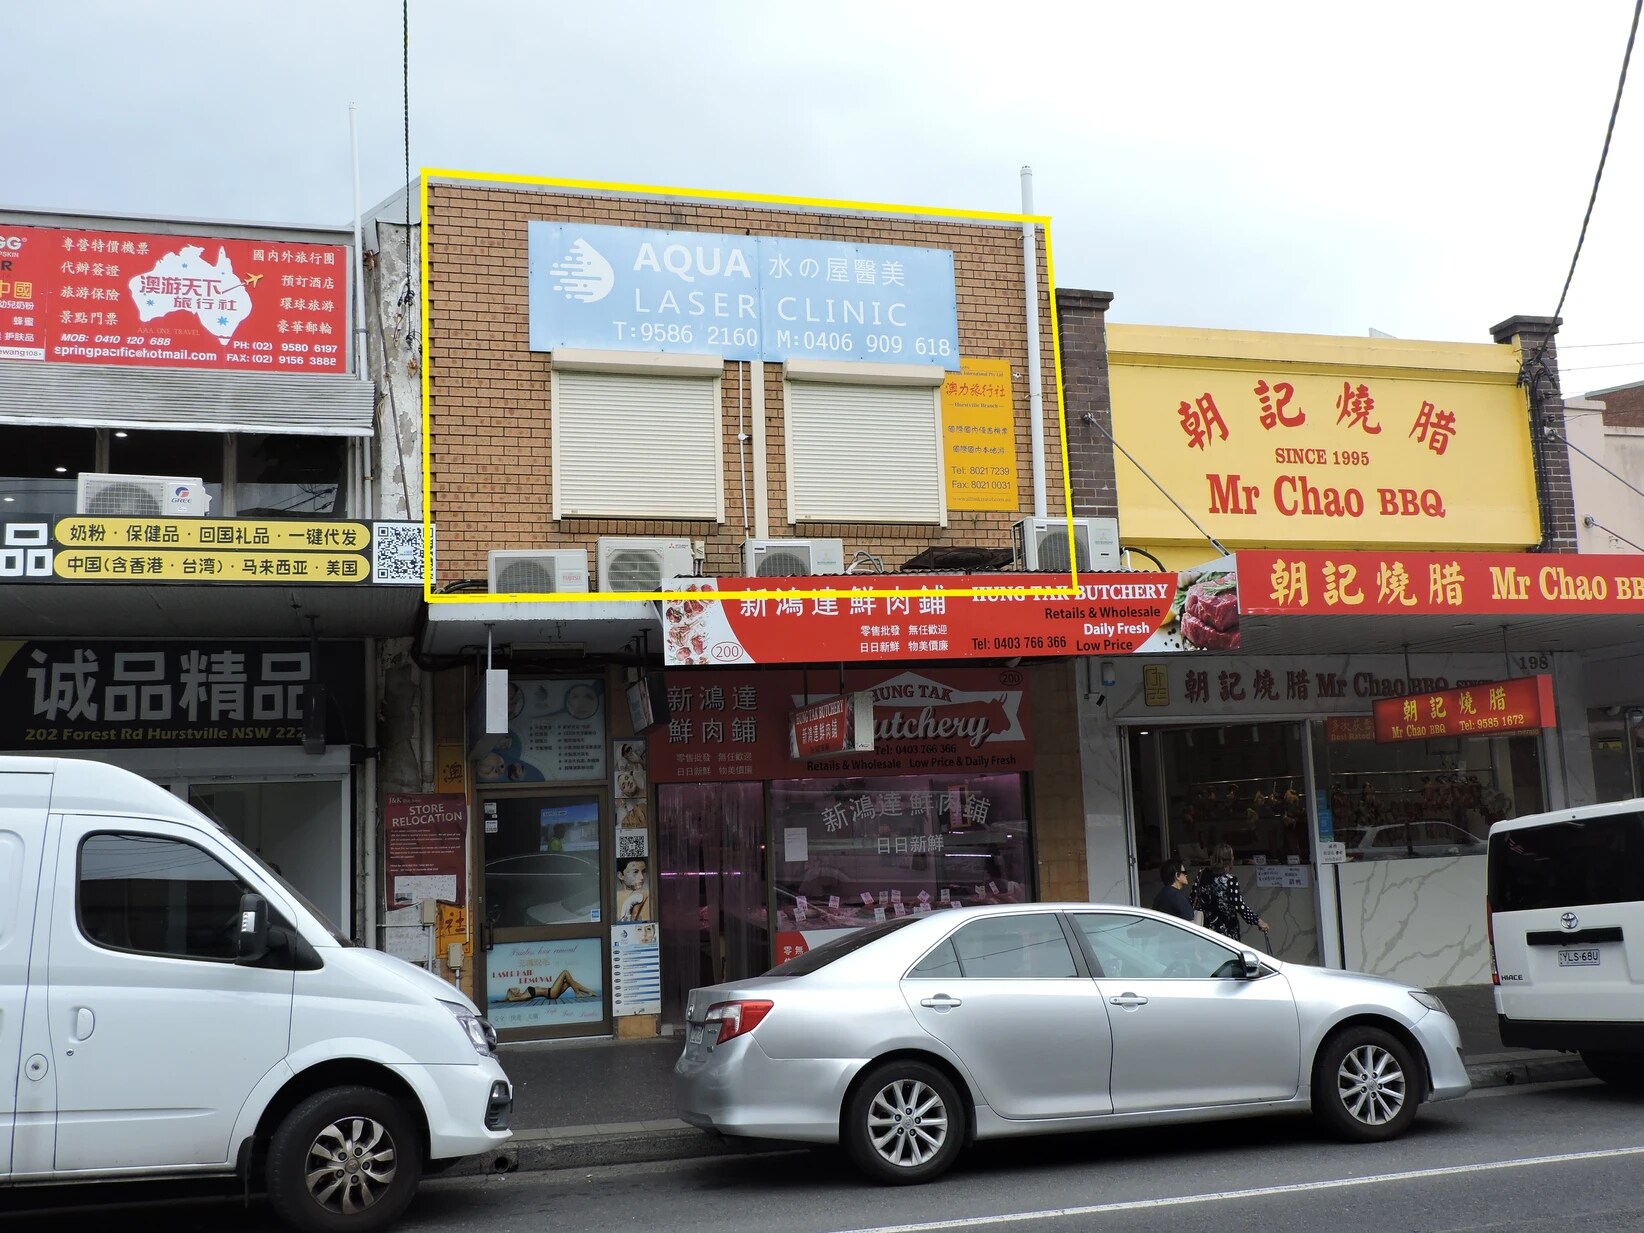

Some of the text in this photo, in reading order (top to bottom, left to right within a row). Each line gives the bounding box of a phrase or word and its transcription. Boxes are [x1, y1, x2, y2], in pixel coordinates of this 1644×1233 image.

[633, 243, 751, 283] AQUA
[769, 253, 905, 287] 水の屋醫美
[140, 275, 222, 297] 澳游天下
[281, 275, 334, 289] 預訂酒店
[173, 296, 238, 311] 旅行社
[635, 288, 907, 327] LASER CLINIC
[59, 310, 118, 326] 景點門票
[277, 319, 332, 334] 豪華郵輪
[61, 333, 171, 346] MOB: 0410 120 688
[174, 328, 200, 336] TRAVEL
[233, 340, 338, 353] PH: (02) 9580 6197
[707, 326, 758, 347] 2160
[866, 333, 903, 354] 909
[914, 337, 951, 357] 618
[54, 345, 217, 362] springpacific@hotmail.com
[226, 353, 337, 366] FAX: (02) 9156 3888
[945, 381, 1006, 398] 澳力旅行社
[1275, 446, 1370, 467] SINCE 1995
[951, 466, 1010, 476] Tel: 8021 7239
[951, 480, 1011, 490] Fax: 8021 0031
[1206, 473, 1447, 519] Mr Chao BBQ
[1489, 566, 1531, 601] Mr
[1538, 565, 1608, 601] Chao
[740, 585, 946, 617] 新鴻達鮮肉鋪
[971, 583, 1169, 602] HUNG TAK BUTCHERY
[1045, 605, 1161, 619] Retails & Wholesale
[1083, 621, 1150, 638] Daily Fresh
[714, 645, 740, 658] 200
[860, 640, 949, 653] 日日新鮮 物美價廉
[972, 636, 1067, 650] Tel: 0403 766 366
[1076, 639, 1133, 652] Low Price
[1518, 655, 1549, 670] 198
[27, 648, 311, 722] 诚品精品
[1002, 673, 1020, 682] 200
[1316, 672, 1348, 698] Mr
[1352, 671, 1405, 698] Chao
[667, 685, 759, 712] 新鴻達
[919, 684, 953, 702] TAK
[25, 726, 303, 741] 202 Forest Rd Hurstville NSW 222
[668, 716, 757, 744] 鮮肉鋪
[874, 705, 990, 748] utchery
[1391, 713, 1525, 739] Mr Chao BBQ Tel: 9585 1672
[875, 745, 893, 756] Tel:
[896, 744, 918, 755] 0403
[920, 744, 938, 754] 766
[807, 754, 1016, 772] Retails & Wholesale Low Price & Daily Fresh
[408, 803, 445, 816] STORE
[821, 792, 992, 833] 新鴻達鮮肉鋪
[392, 811, 463, 828] RELOCATION
[877, 834, 945, 855] 日日新鮮
